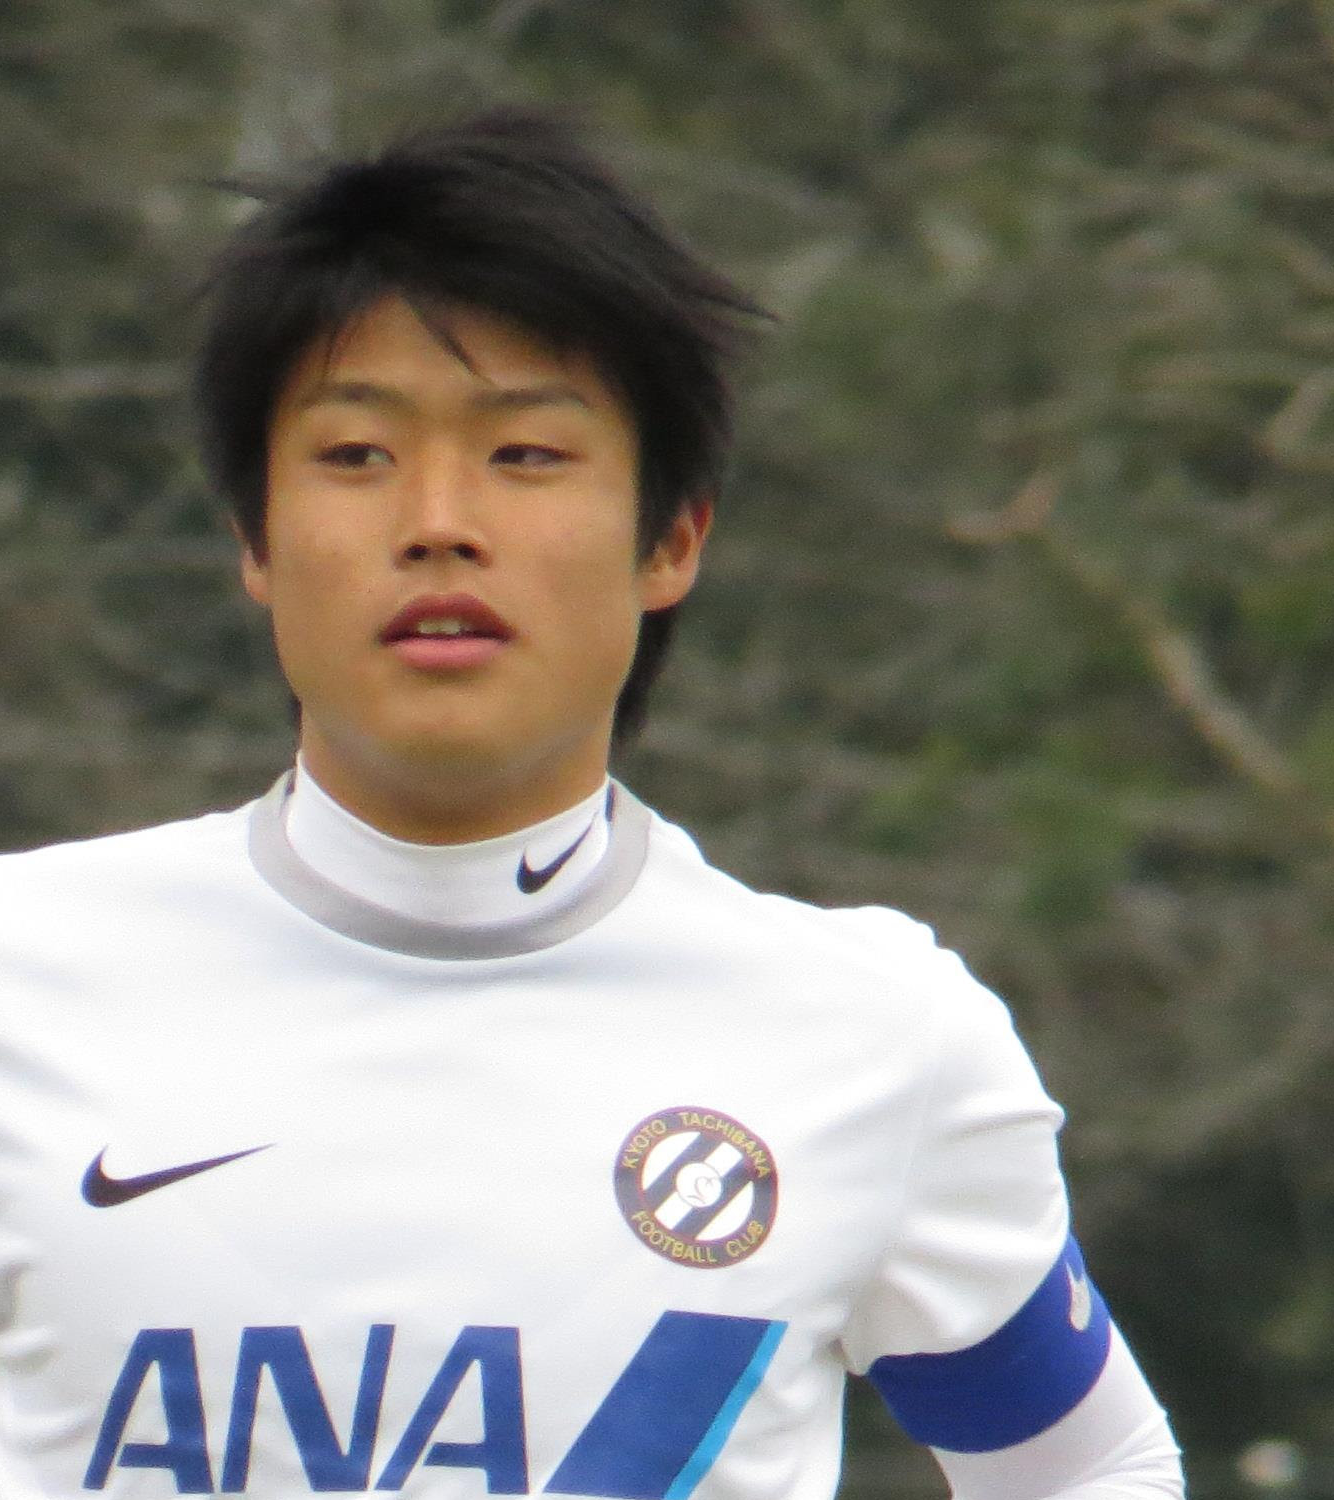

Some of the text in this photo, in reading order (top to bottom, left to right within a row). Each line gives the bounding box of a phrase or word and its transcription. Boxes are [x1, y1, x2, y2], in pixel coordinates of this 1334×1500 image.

[621, 1111, 771, 1178] KYOTO TACHIBANA
[631, 1210, 765, 1264] FOOTBALL CLUB
[83, 1323, 530, 1495] ANA
